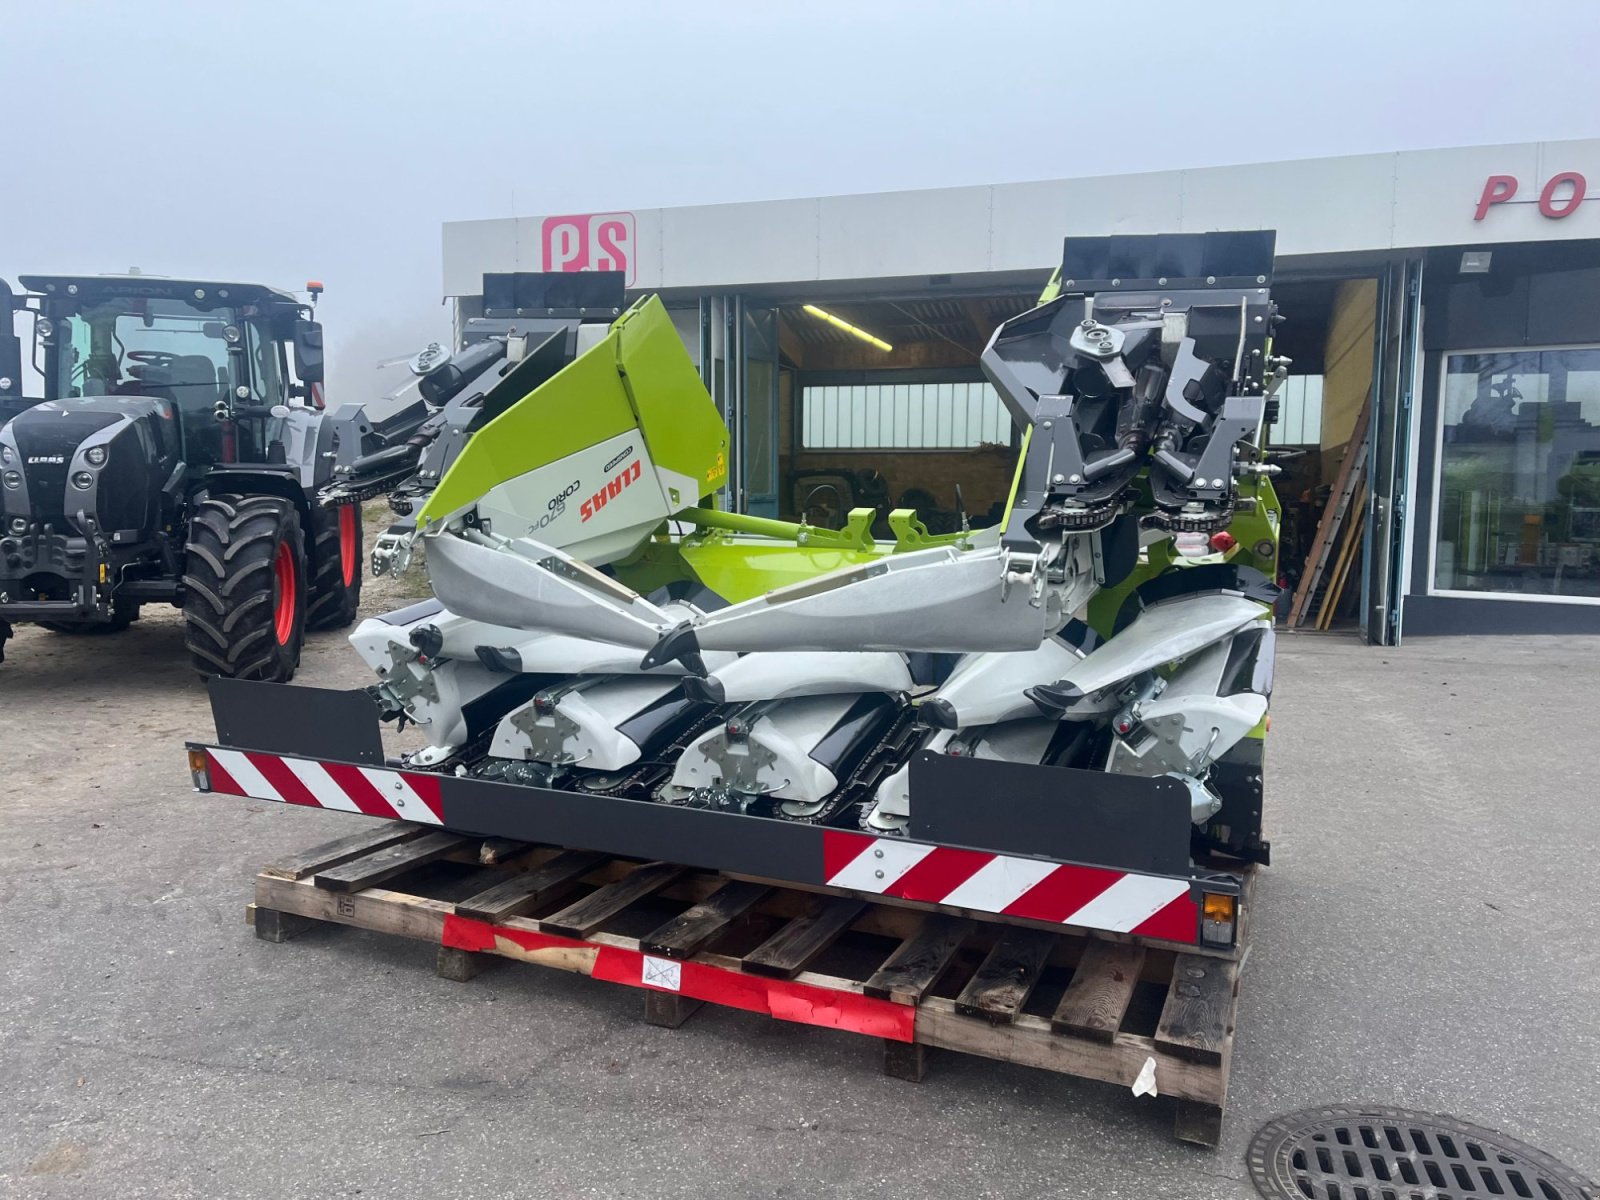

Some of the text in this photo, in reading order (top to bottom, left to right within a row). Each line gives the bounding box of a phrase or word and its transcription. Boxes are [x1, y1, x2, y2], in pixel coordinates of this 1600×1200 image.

[28, 456, 64, 464] CLAAS
[548, 480, 580, 510] CORIO
[580, 459, 641, 523] CLAAS
